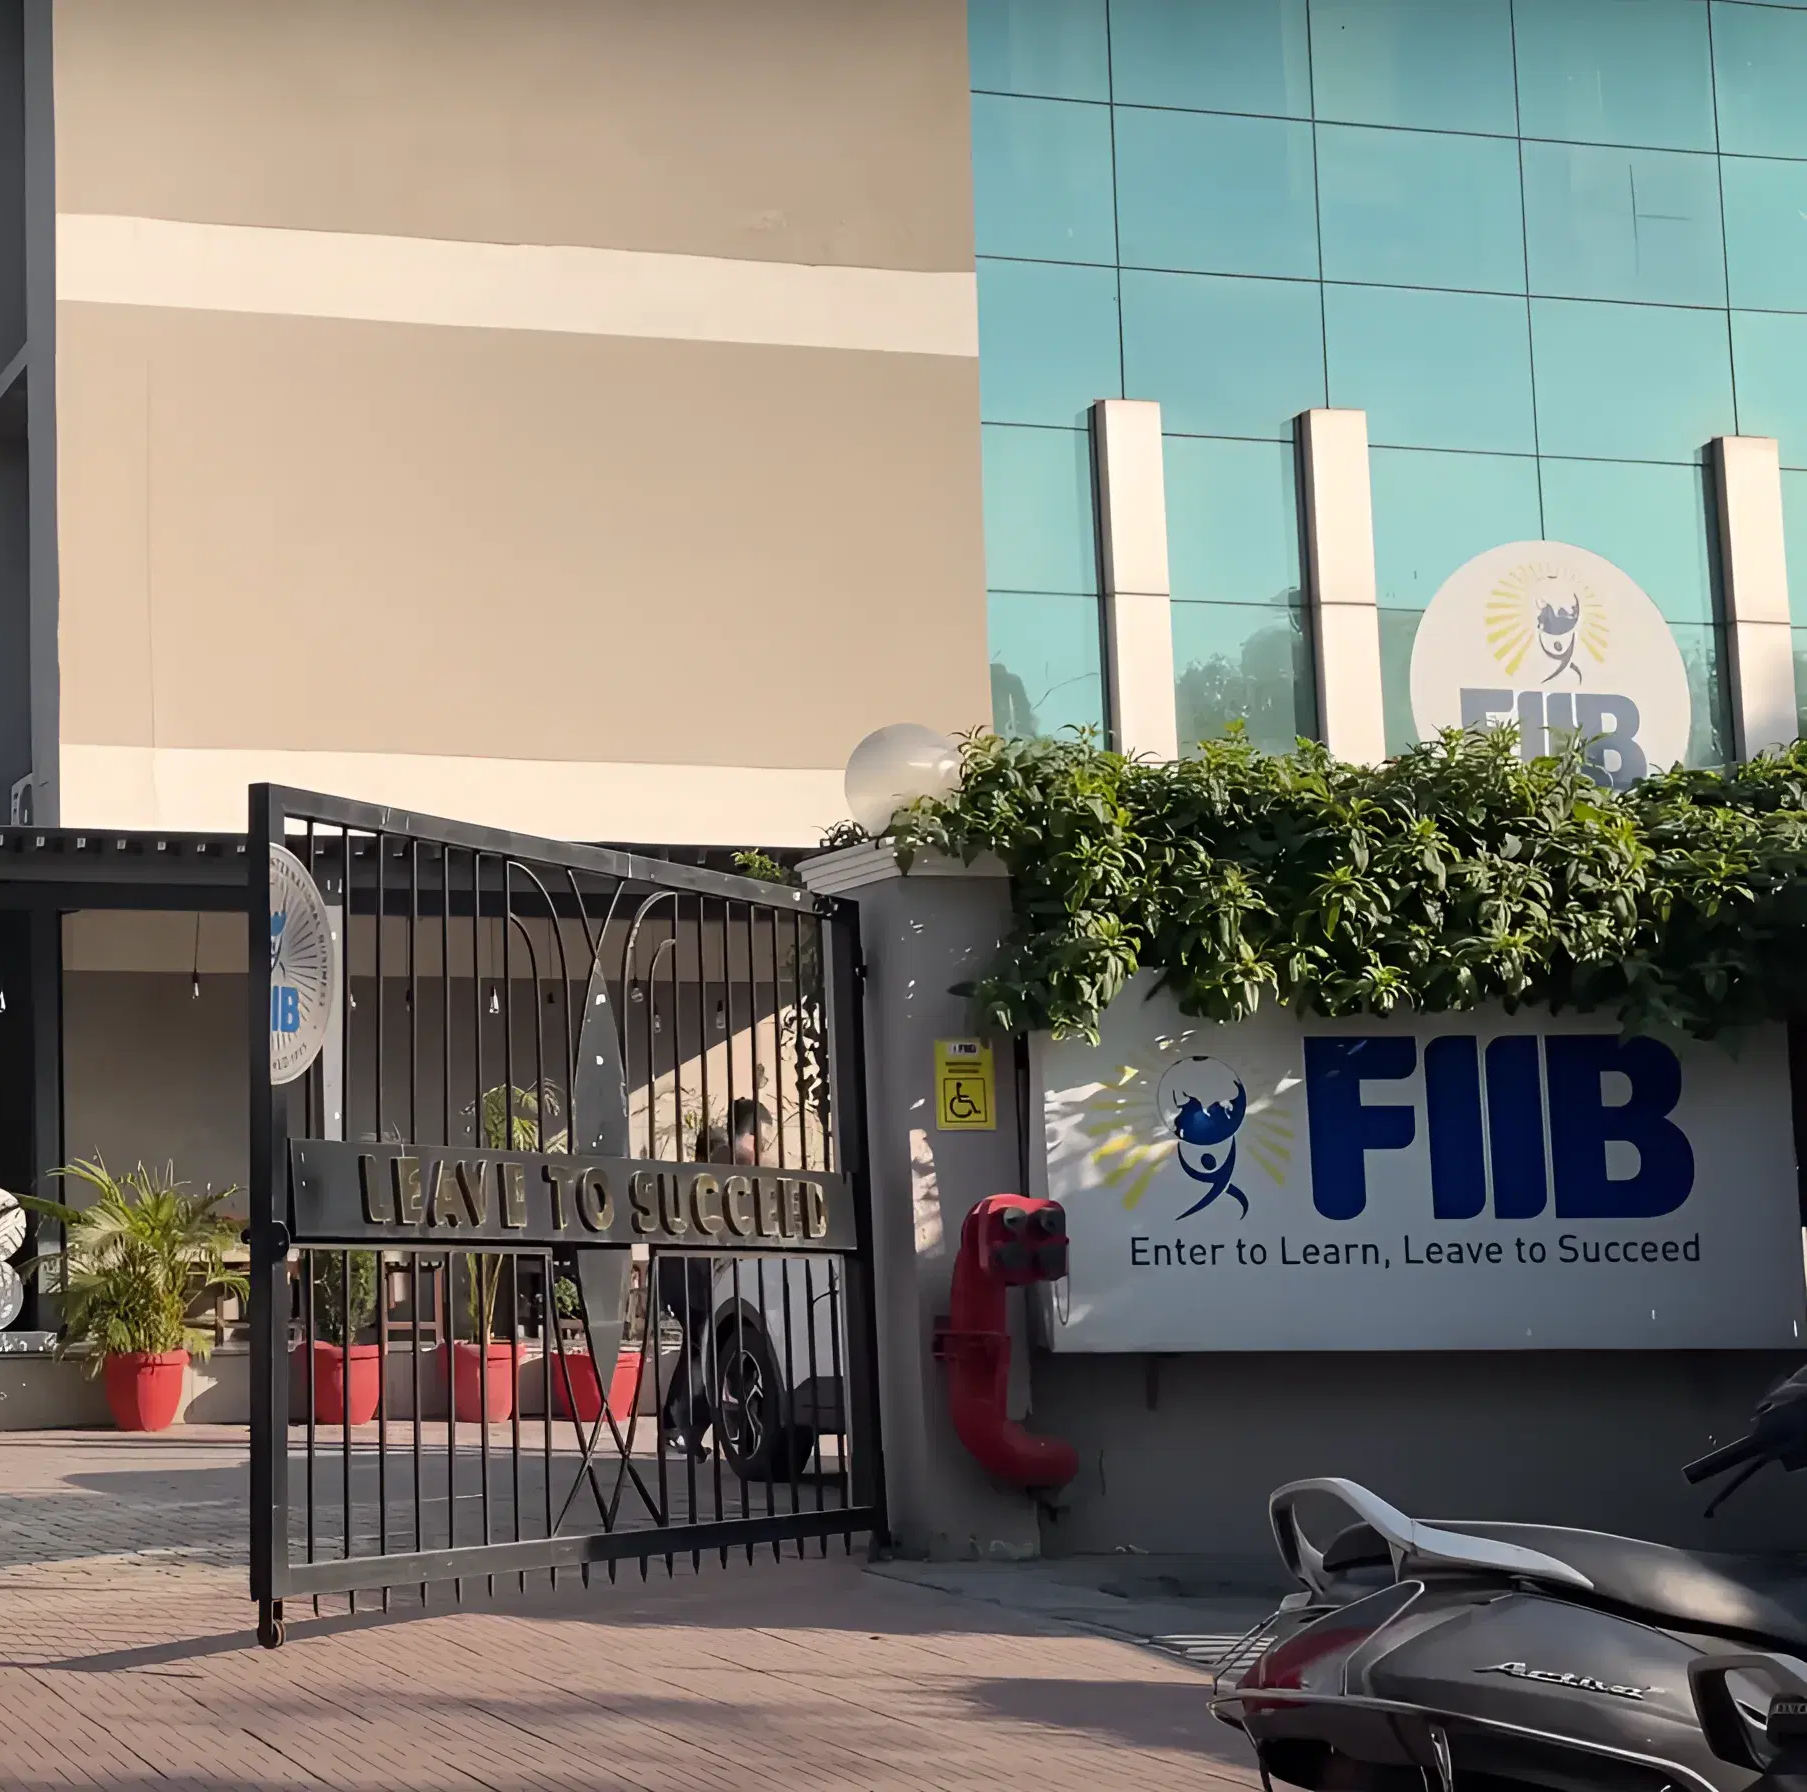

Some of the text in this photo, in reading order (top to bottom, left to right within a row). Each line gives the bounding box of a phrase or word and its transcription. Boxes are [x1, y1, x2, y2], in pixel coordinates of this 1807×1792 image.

[1303, 1034, 1696, 1221] FIIB
[358, 1153, 830, 1240] LEAVE TO SUCCEED
[1130, 1232, 1701, 1269] Enter to Learn, Leave to Succeed
